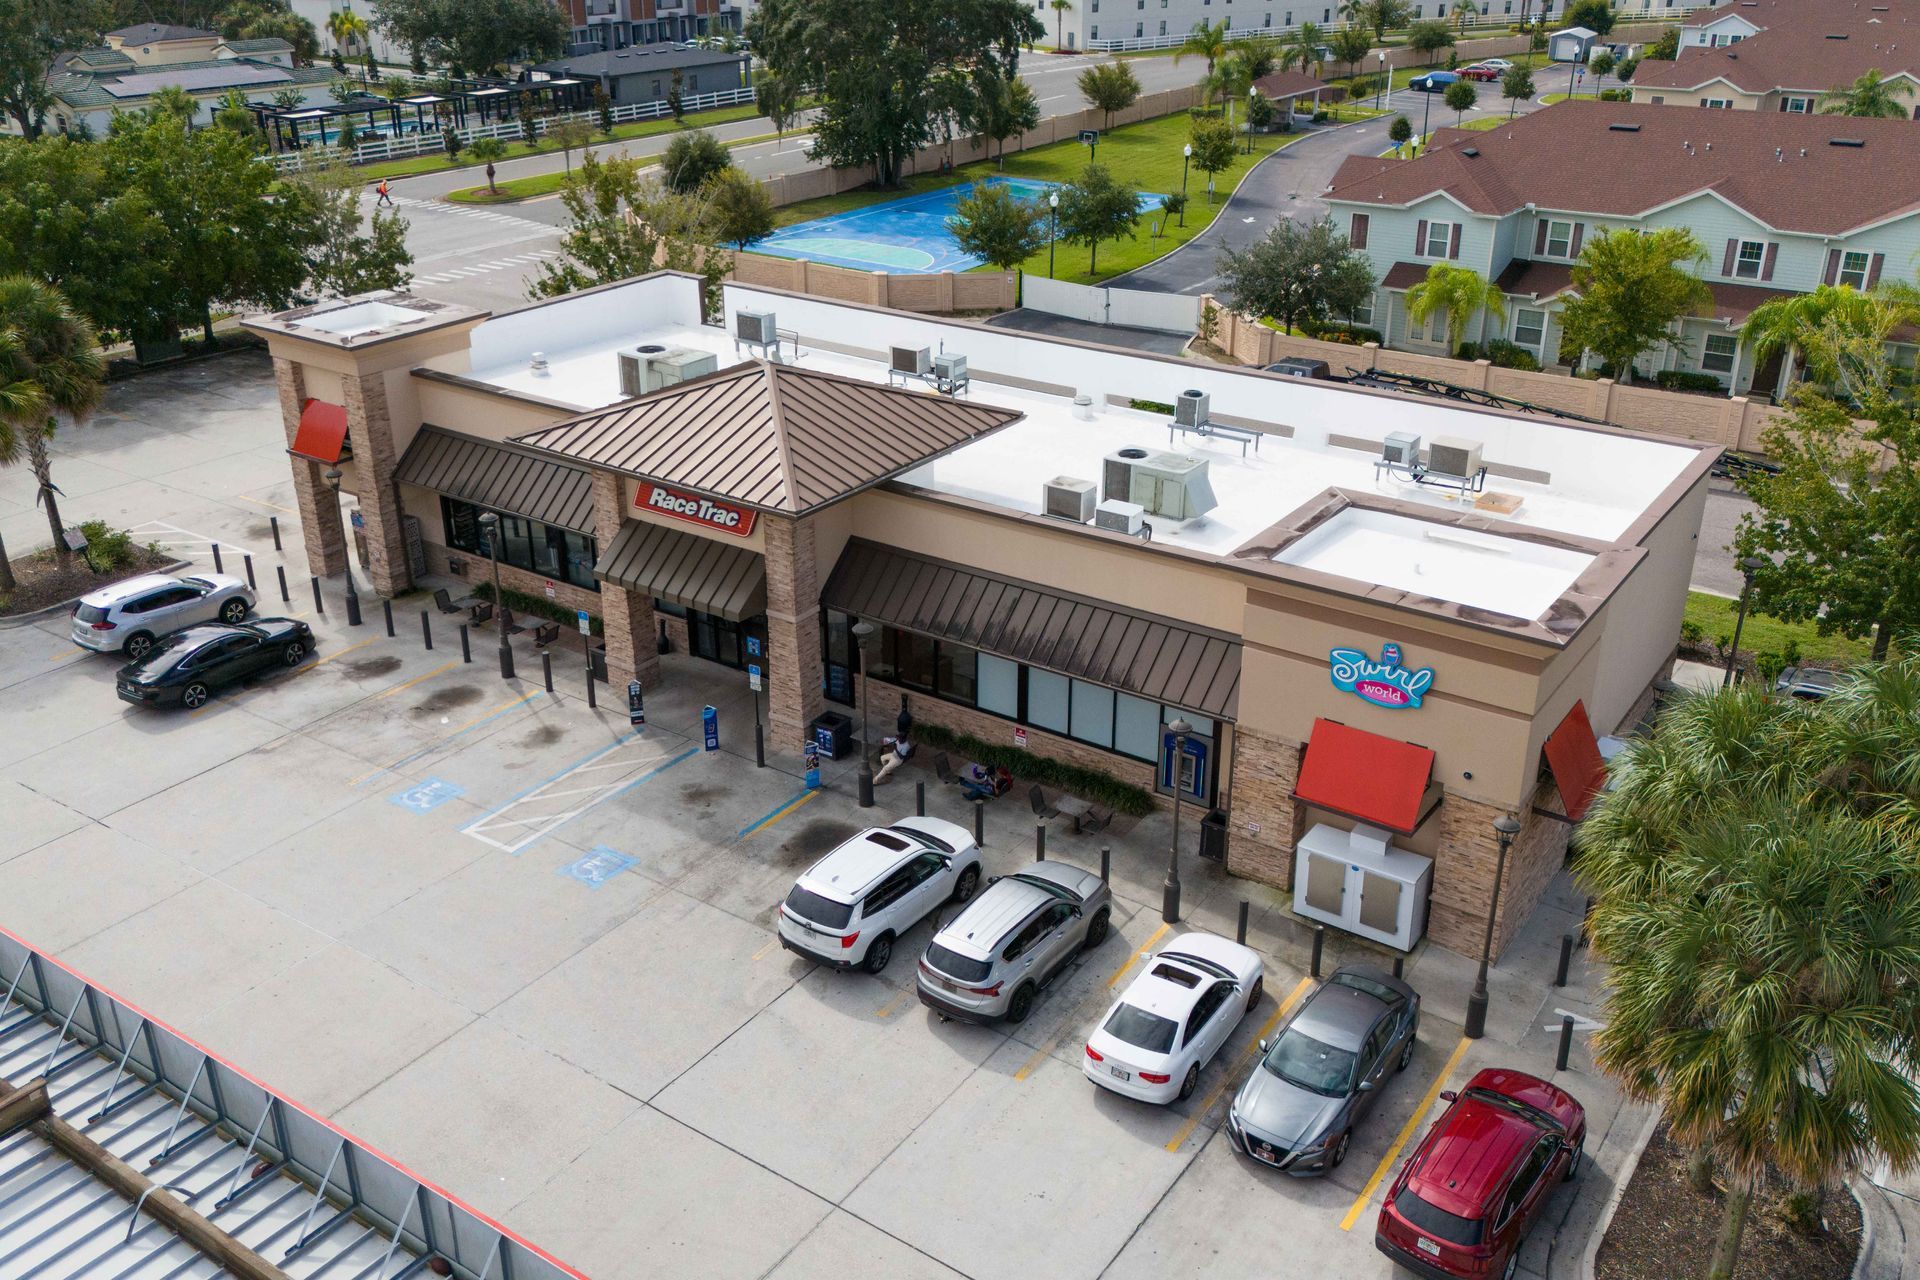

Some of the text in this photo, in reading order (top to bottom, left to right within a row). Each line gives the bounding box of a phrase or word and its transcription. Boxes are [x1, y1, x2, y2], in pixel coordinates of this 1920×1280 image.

[648, 487, 740, 527] RaceTrac
[1332, 650, 1431, 700] Swirl
[1363, 683, 1401, 702] world
